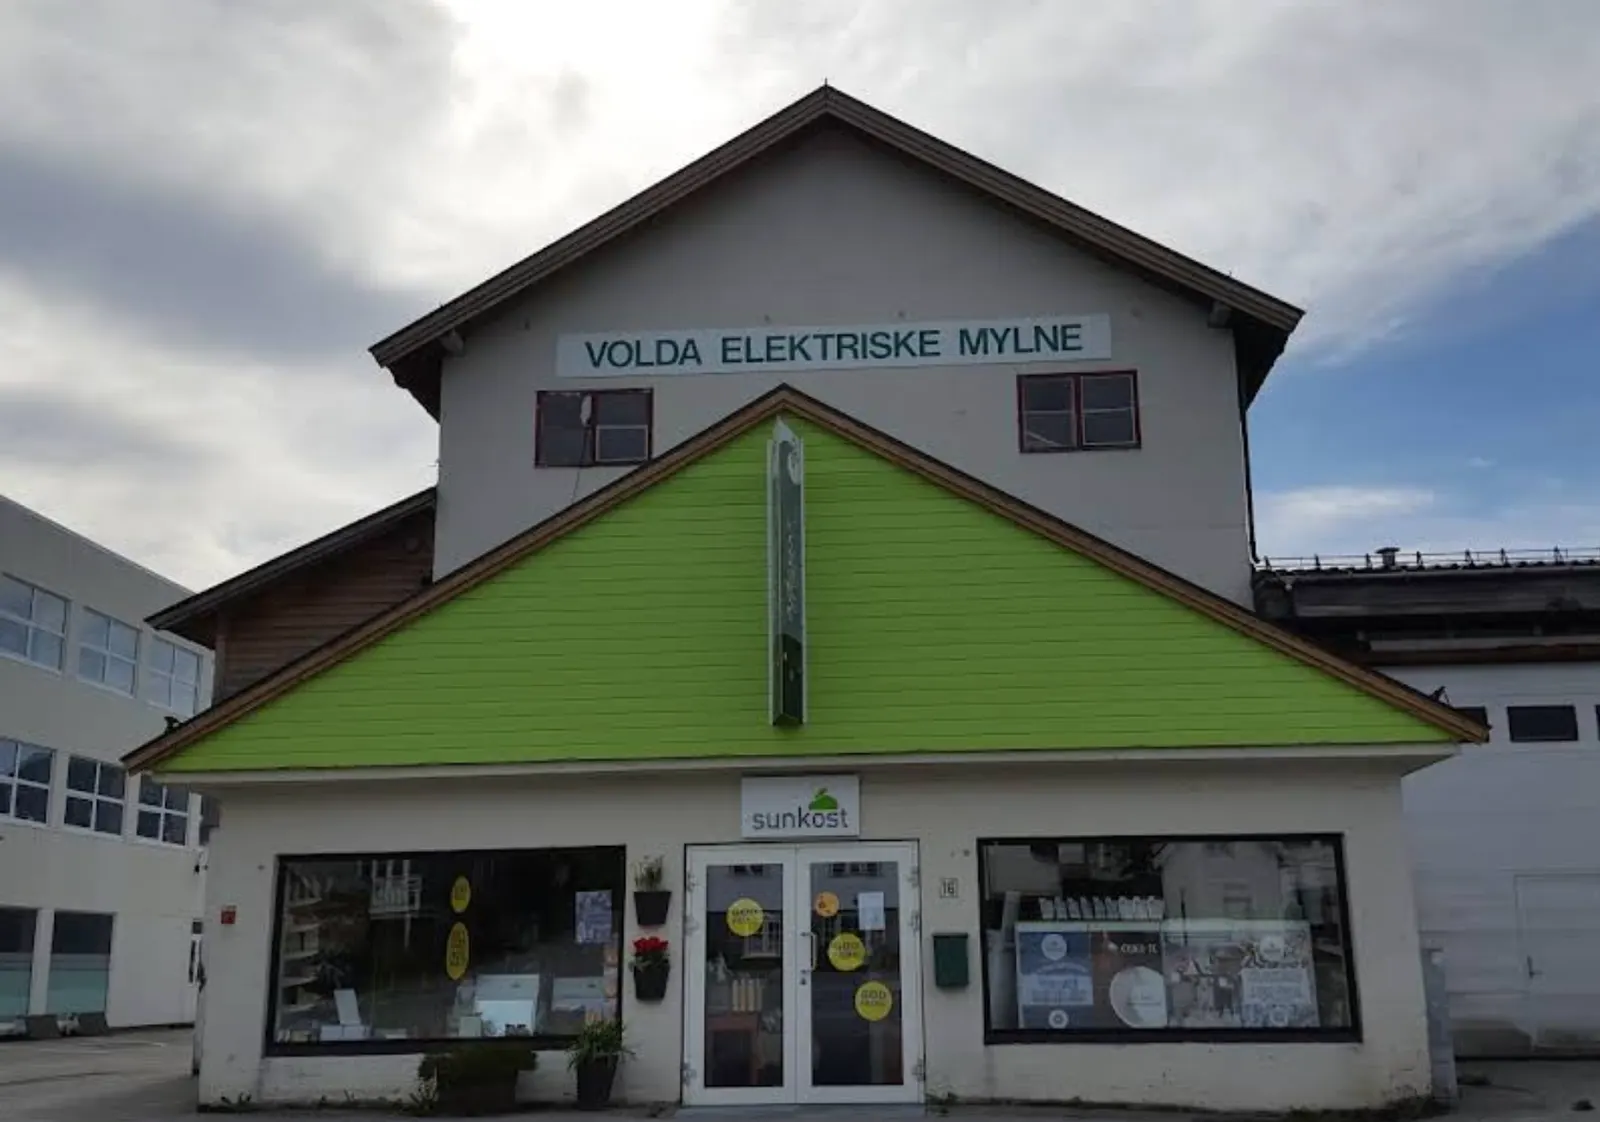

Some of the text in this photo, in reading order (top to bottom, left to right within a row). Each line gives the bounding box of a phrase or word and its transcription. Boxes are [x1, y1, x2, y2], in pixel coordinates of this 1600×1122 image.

[585, 324, 1082, 367] VOLDA ELEKTRISKE MYLNE
[752, 807, 849, 830] sunkost
[942, 881, 955, 895] 16
